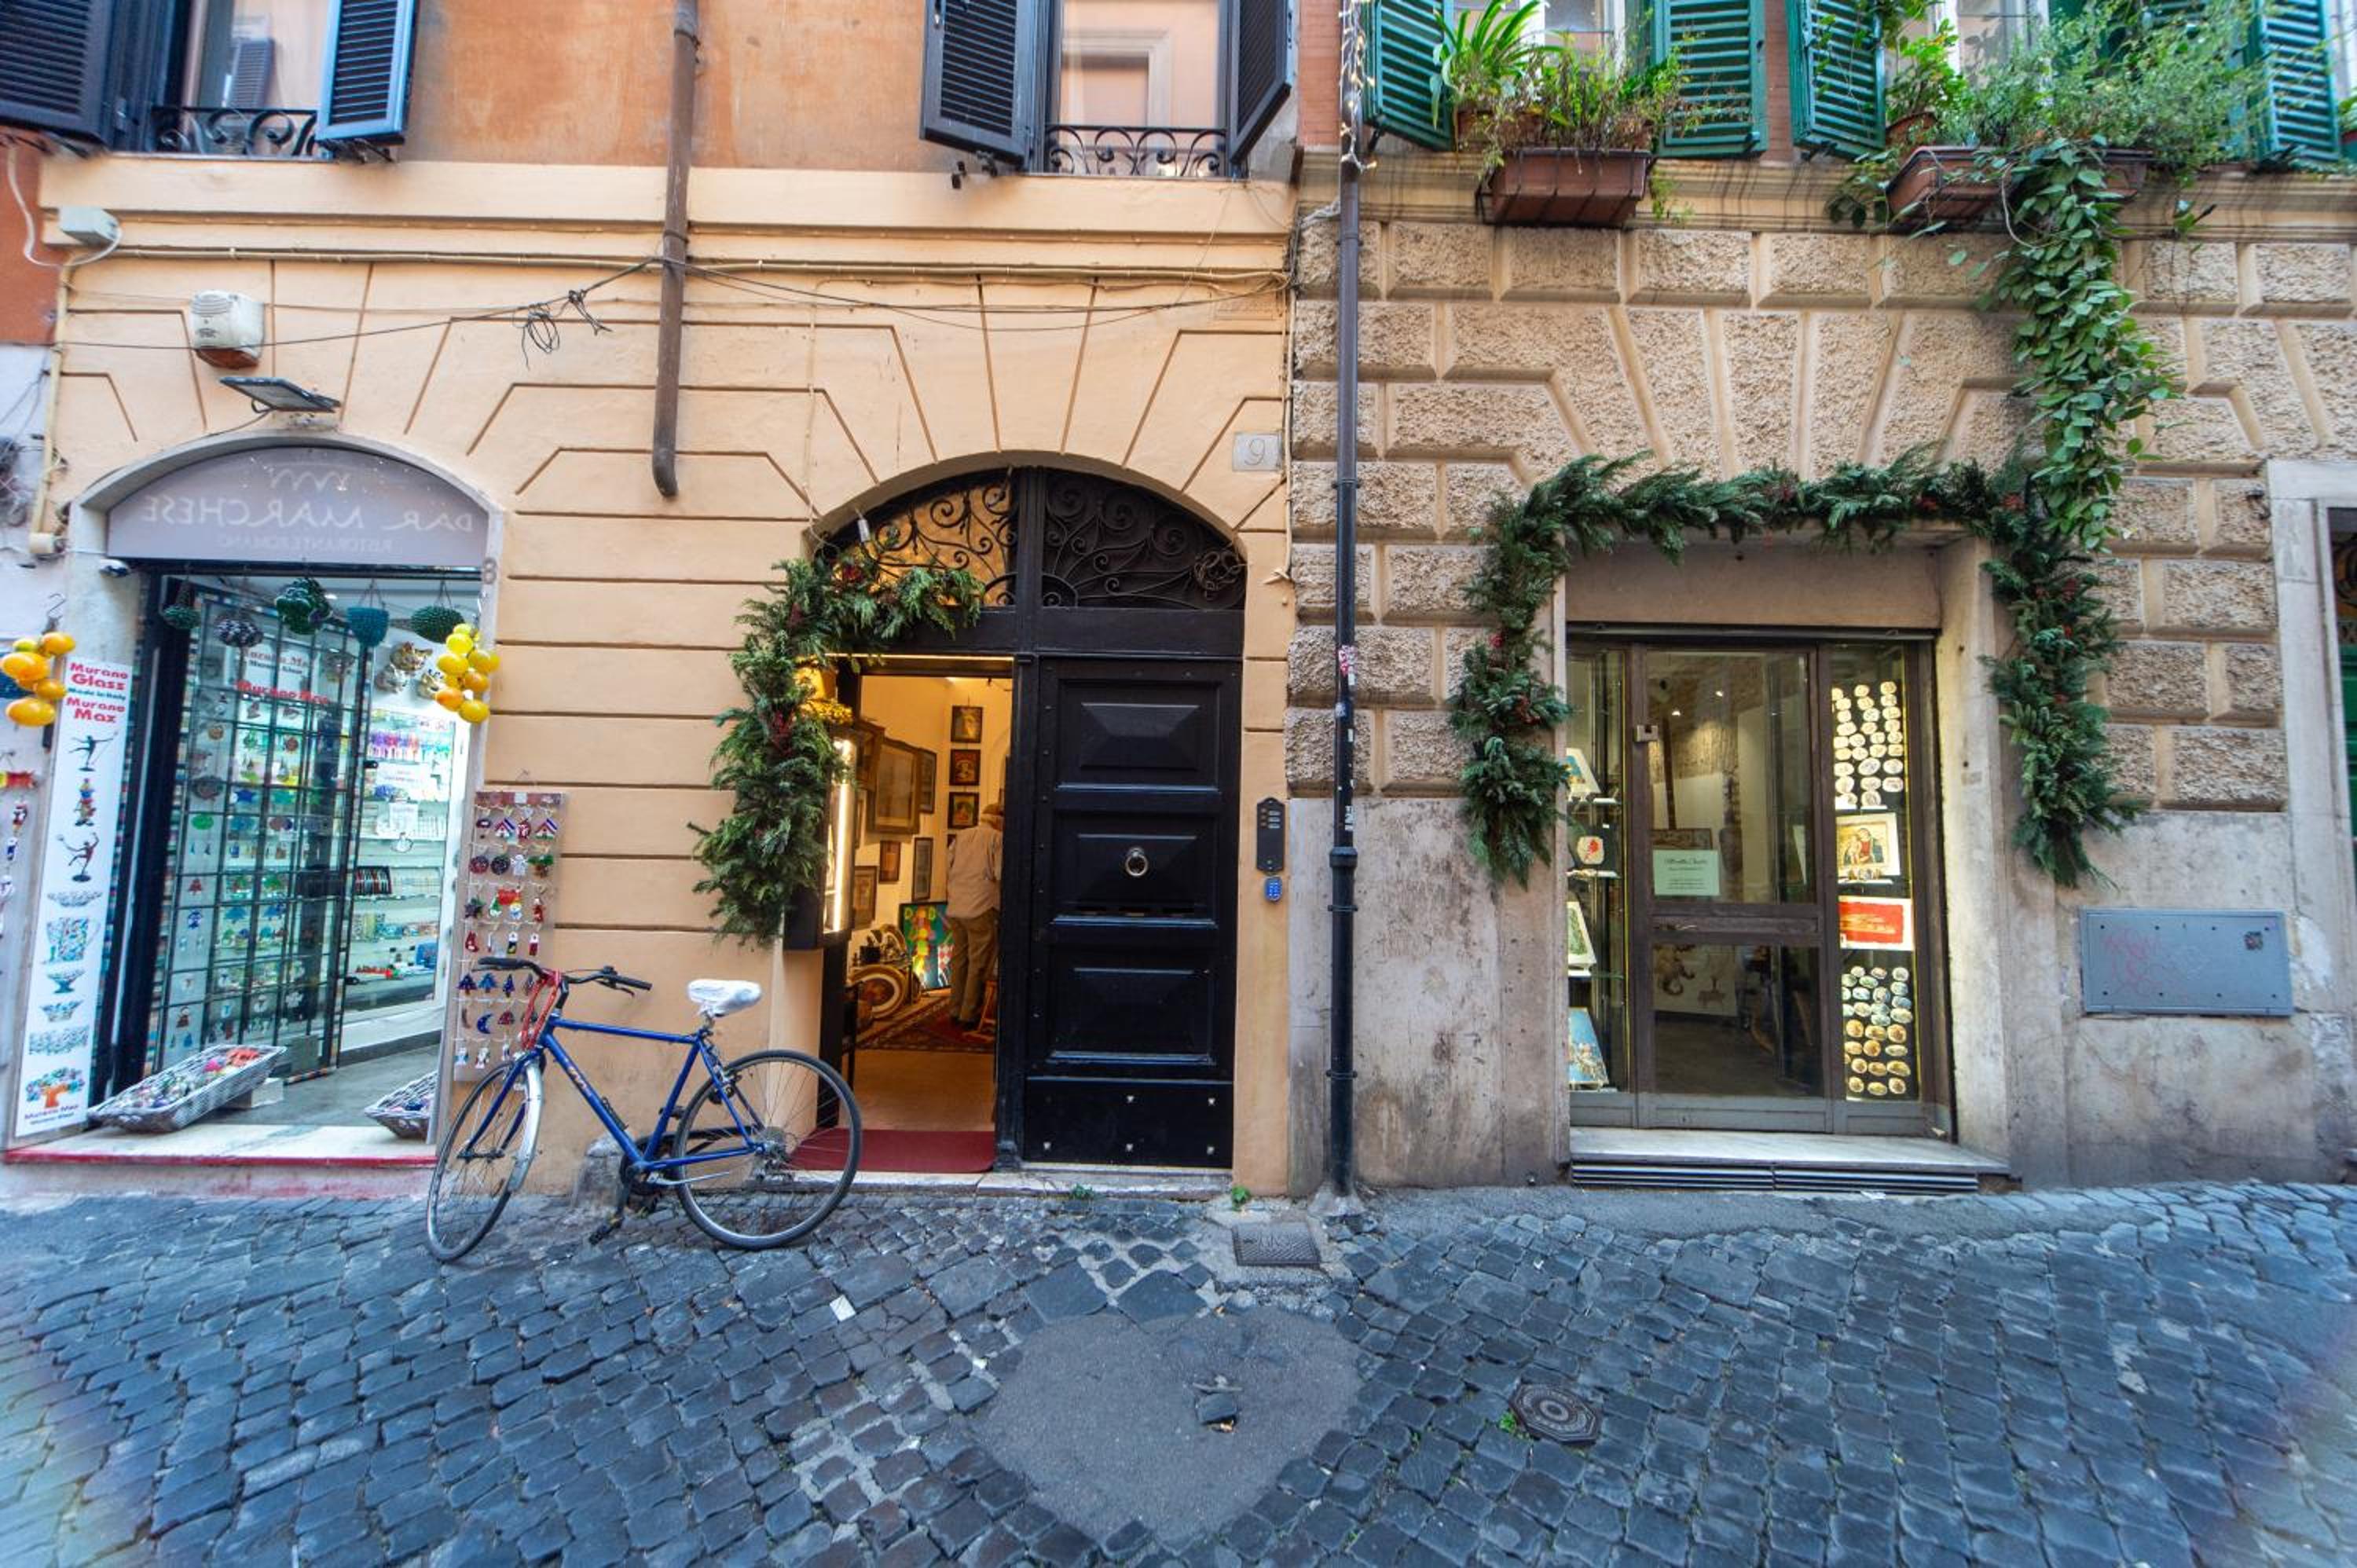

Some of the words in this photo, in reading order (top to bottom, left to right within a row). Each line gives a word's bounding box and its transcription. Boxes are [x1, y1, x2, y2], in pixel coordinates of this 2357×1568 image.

[1243, 438, 1266, 466] 9
[483, 557, 497, 585] 8
[69, 662, 128, 680] Murano
[71, 673, 126, 691] Glass
[66, 697, 126, 713] Murano
[75, 709, 116, 723] Max
